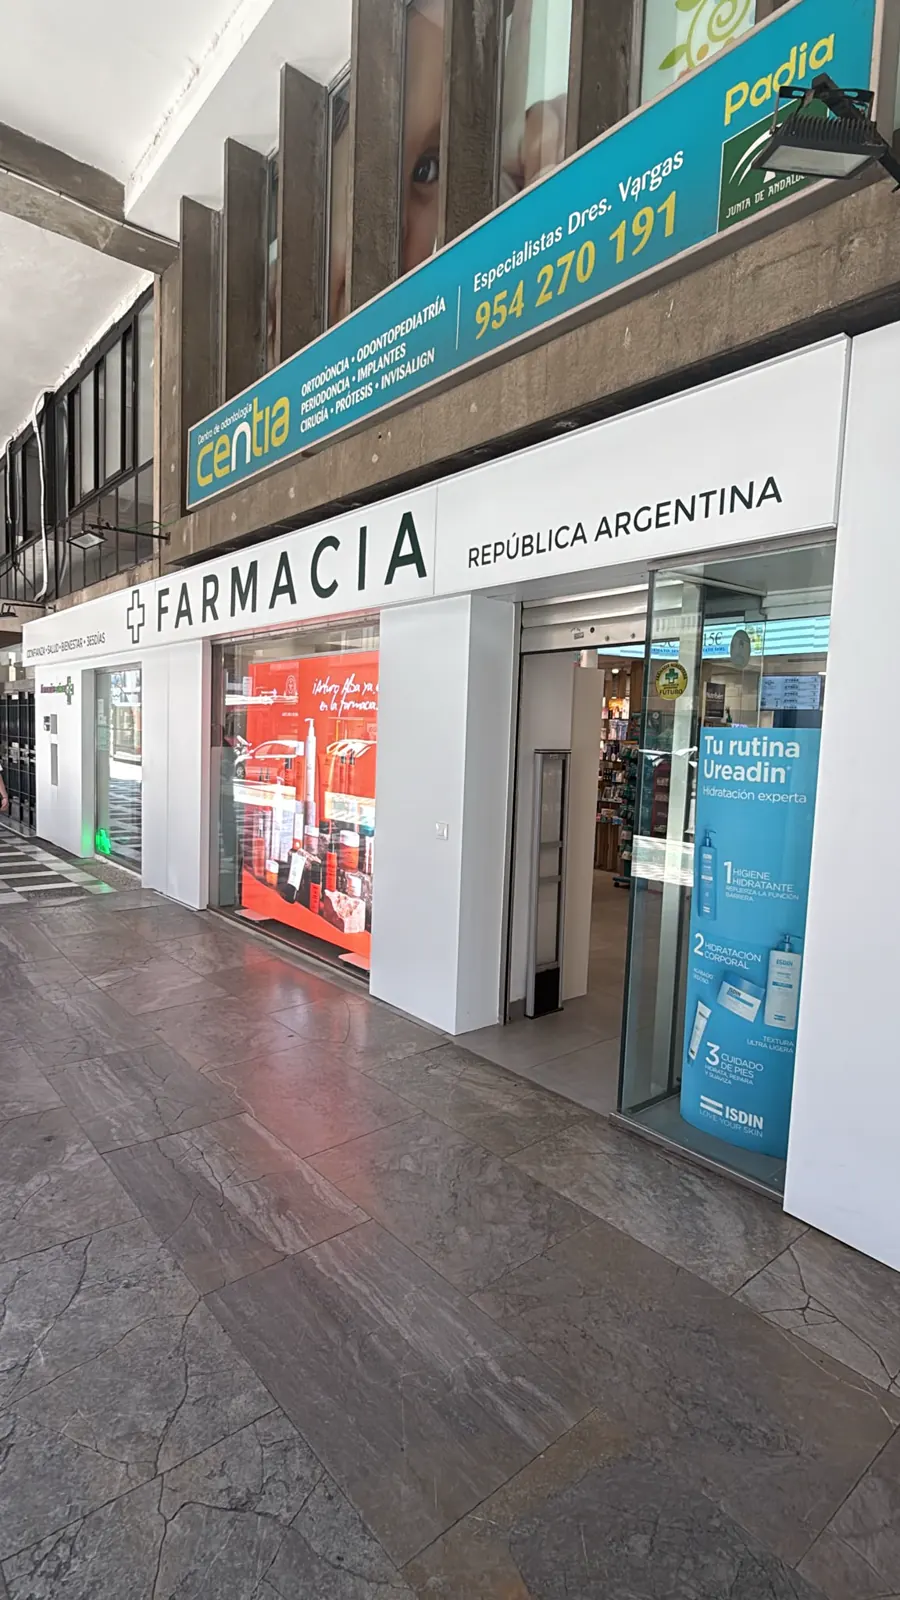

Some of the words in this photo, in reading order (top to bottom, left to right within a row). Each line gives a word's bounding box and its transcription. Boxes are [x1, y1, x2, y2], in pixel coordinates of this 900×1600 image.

[724, 33, 835, 126] Padia
[726, 197, 751, 219] JUNTA
[754, 189, 766, 204] DE
[473, 226, 563, 292] Especialistas
[567, 198, 612, 235] Dres.
[618, 150, 684, 202] Vargas
[475, 279, 525, 340] 954
[535, 240, 596, 308] 270
[608, 190, 677, 264] 191
[356, 295, 446, 363] ODONTOPEDIATRÍA
[300, 405, 329, 433] CIRUGÍA
[335, 382, 373, 414] PRÓTESIS
[381, 347, 435, 390] INVISALIGN
[301, 376, 350, 416] PERIODONCIA
[357, 342, 407, 383] IMPLANTES
[197, 430, 213, 445] Centro
[213, 423, 220, 435] de
[220, 403, 252, 430] odontología
[197, 396, 289, 487] centia
[468, 522, 588, 569] REPÚBLICA
[594, 475, 782, 542] ARGENTINA
[157, 511, 428, 633] FARMACIA
[704, 735, 724, 755] Tu
[729, 736, 801, 758] rutina
[703, 759, 786, 784] Ureadin
[703, 785, 755, 800] Hidratación
[757, 791, 807, 803] experta
[724, 861, 732, 884] 1
[732, 868, 770, 880] HIGIENE
[732, 878, 794, 893] HIDRATANTE
[693, 932, 704, 956] 2
[704, 941, 762, 962] HIDRATACIÓN
[704, 951, 750, 970] CORPORAL
[705, 1041, 721, 1066] 3
[746, 1038, 768, 1049] ULTRA
[769, 1043, 794, 1054] LIGERA
[763, 1035, 794, 1047] TEXTURA
[721, 1052, 764, 1072] CUIDADO
[721, 1062, 733, 1073] DE
[734, 1066, 754, 1079] PIES
[699, 1108, 718, 1122] LOVE
[720, 1118, 742, 1130] YOUR
[743, 1126, 763, 1139] SKIN
[725, 1106, 764, 1130] ISDIN
